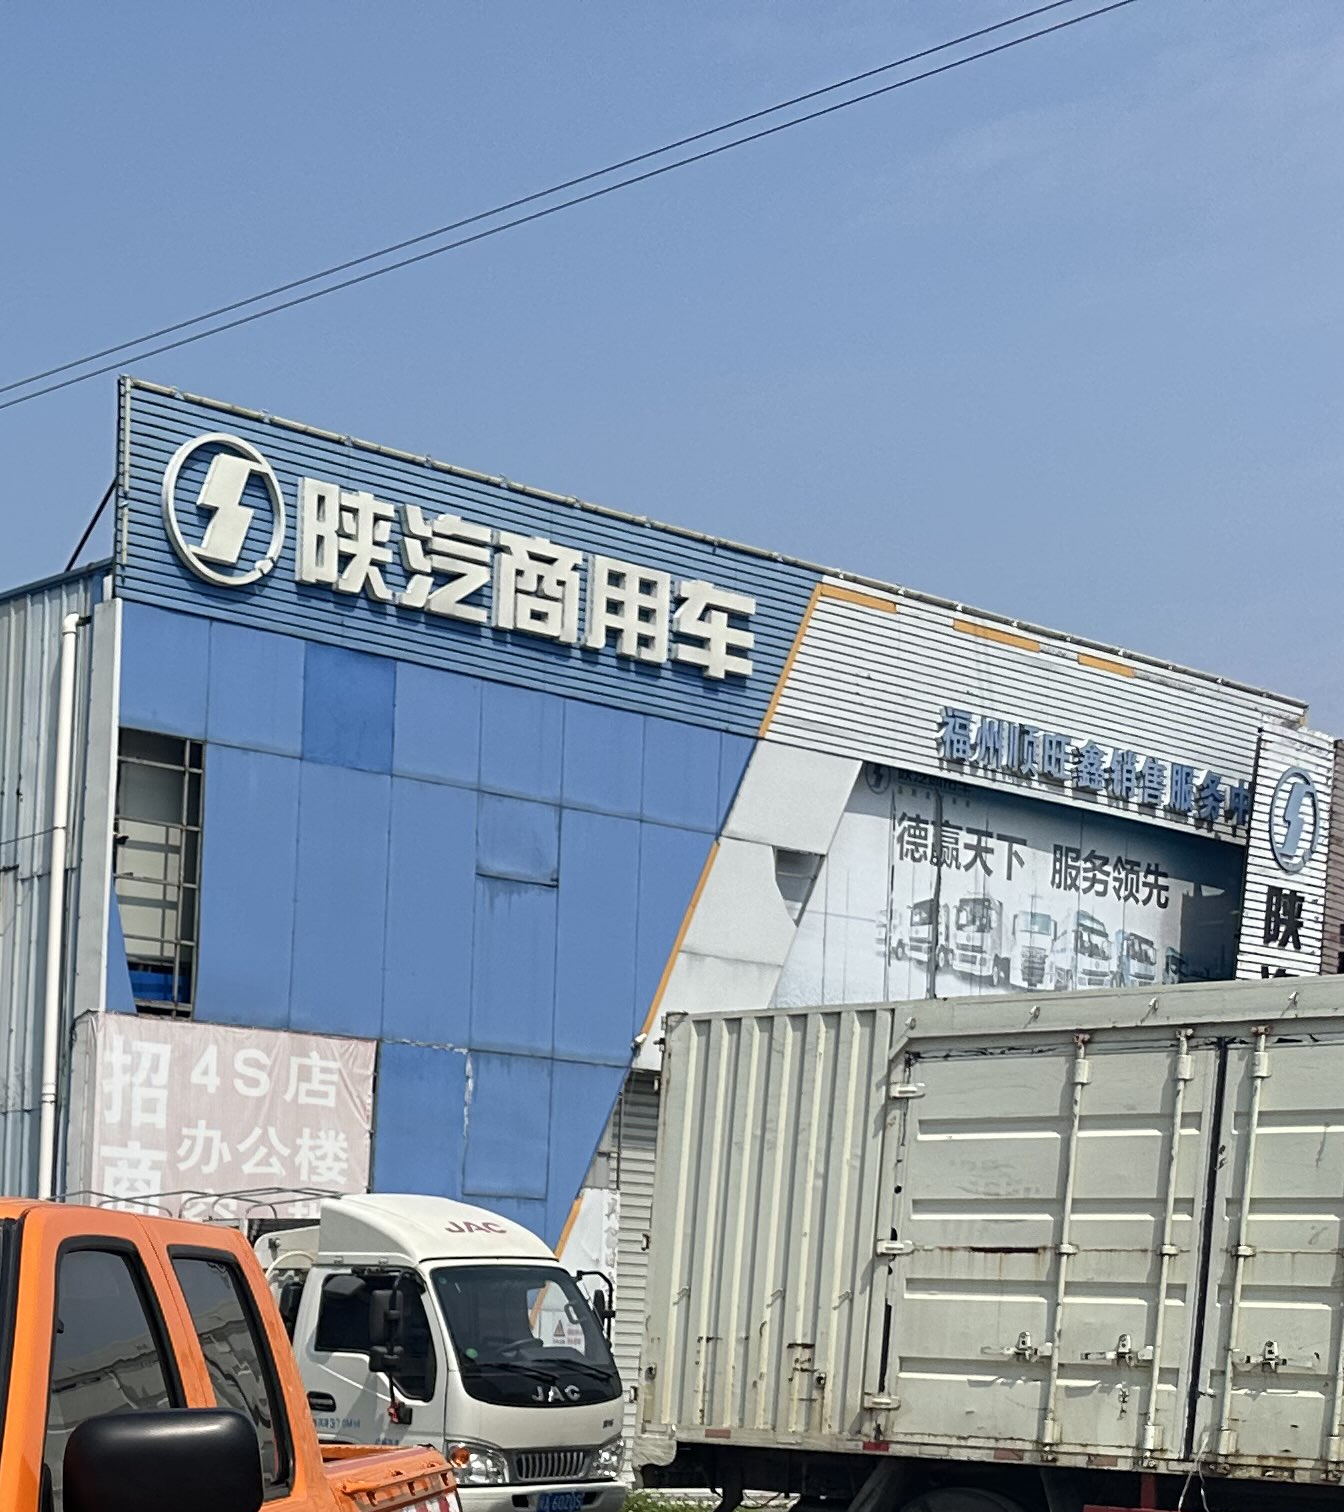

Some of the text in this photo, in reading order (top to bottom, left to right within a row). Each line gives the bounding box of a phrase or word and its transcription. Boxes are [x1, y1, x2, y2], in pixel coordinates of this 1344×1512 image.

[295, 476, 755, 679] 陕汽商用车
[896, 812, 1170, 910] 德赢天下 服务领先
[189, 1043, 340, 1108] 4S店
[177, 1118, 349, 1185] 办公楼
[443, 1220, 508, 1235] JAC
[531, 1384, 582, 1402] JAC
